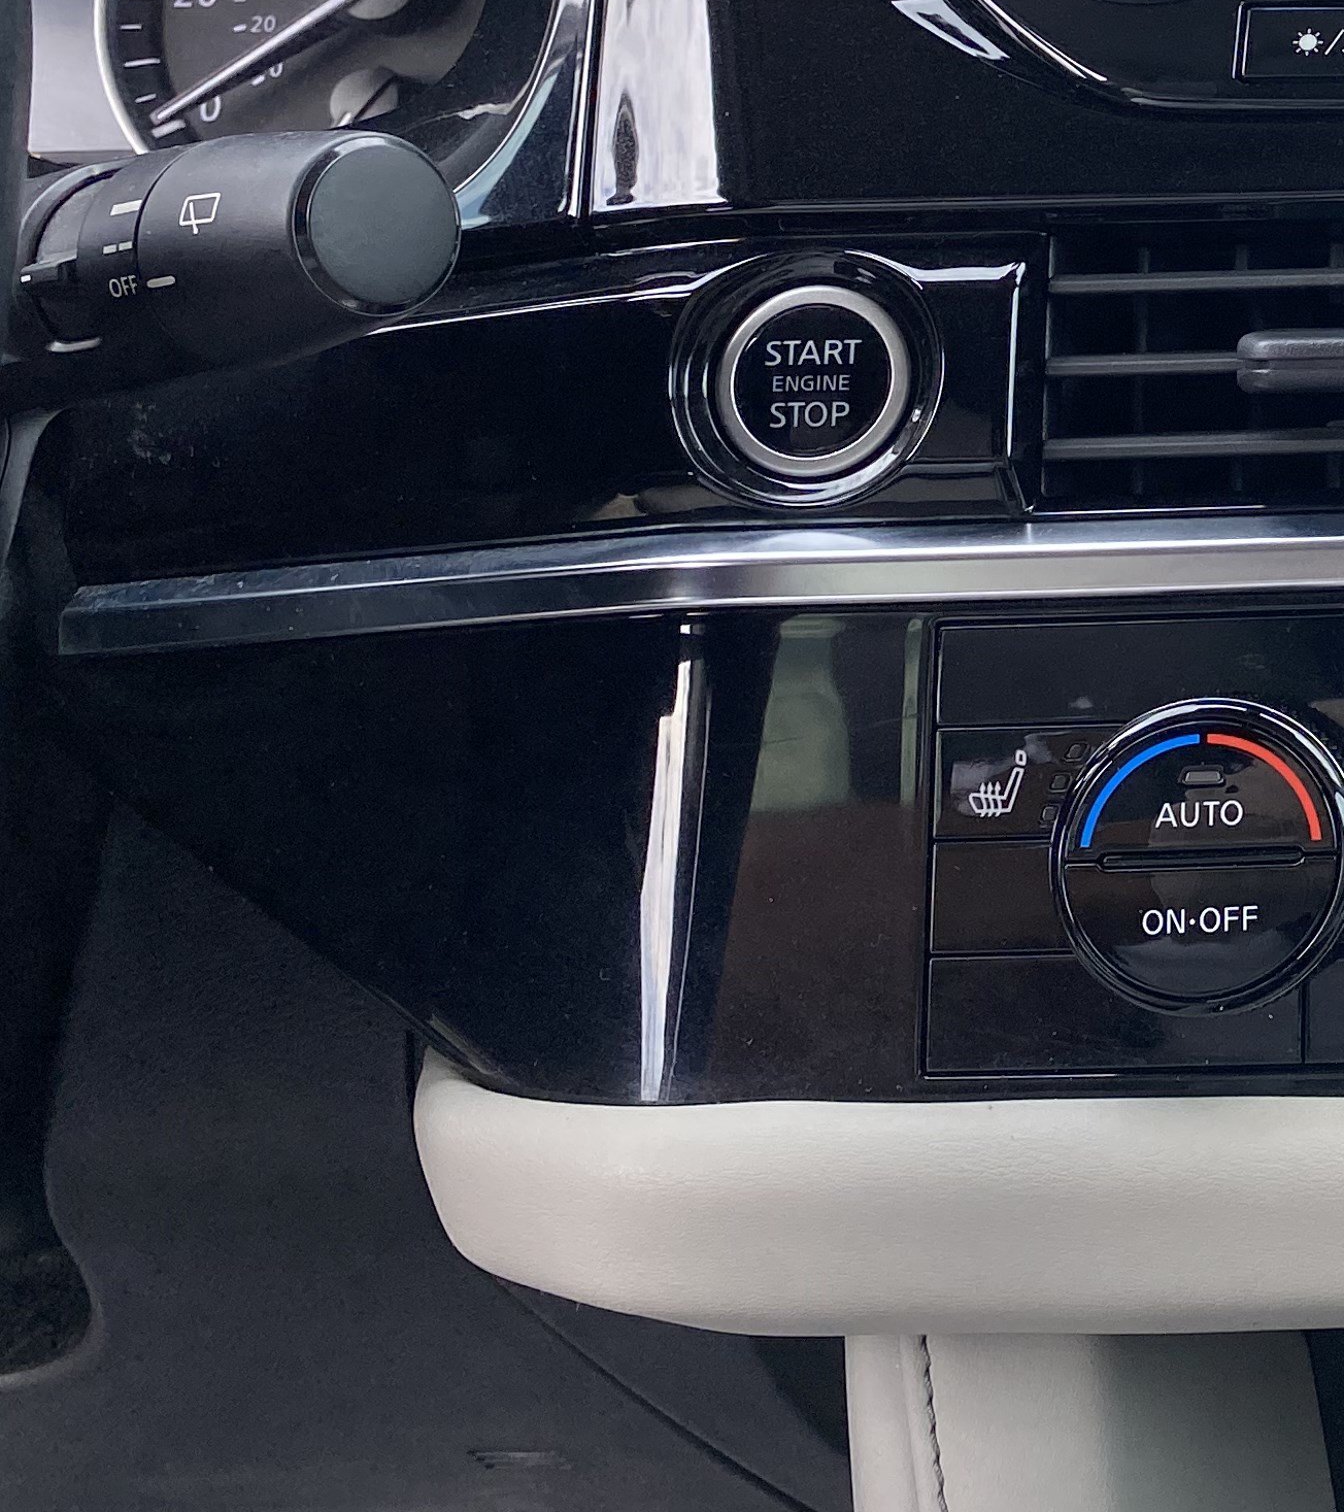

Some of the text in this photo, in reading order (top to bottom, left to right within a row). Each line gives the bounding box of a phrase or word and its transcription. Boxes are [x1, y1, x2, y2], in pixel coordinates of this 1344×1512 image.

[250, 15, 277, 33] 20
[108, 274, 138, 298] OFF
[764, 338, 862, 367] START
[772, 374, 850, 393] ENGINE
[769, 400, 850, 429] STOP
[1154, 799, 1244, 829] AUTO
